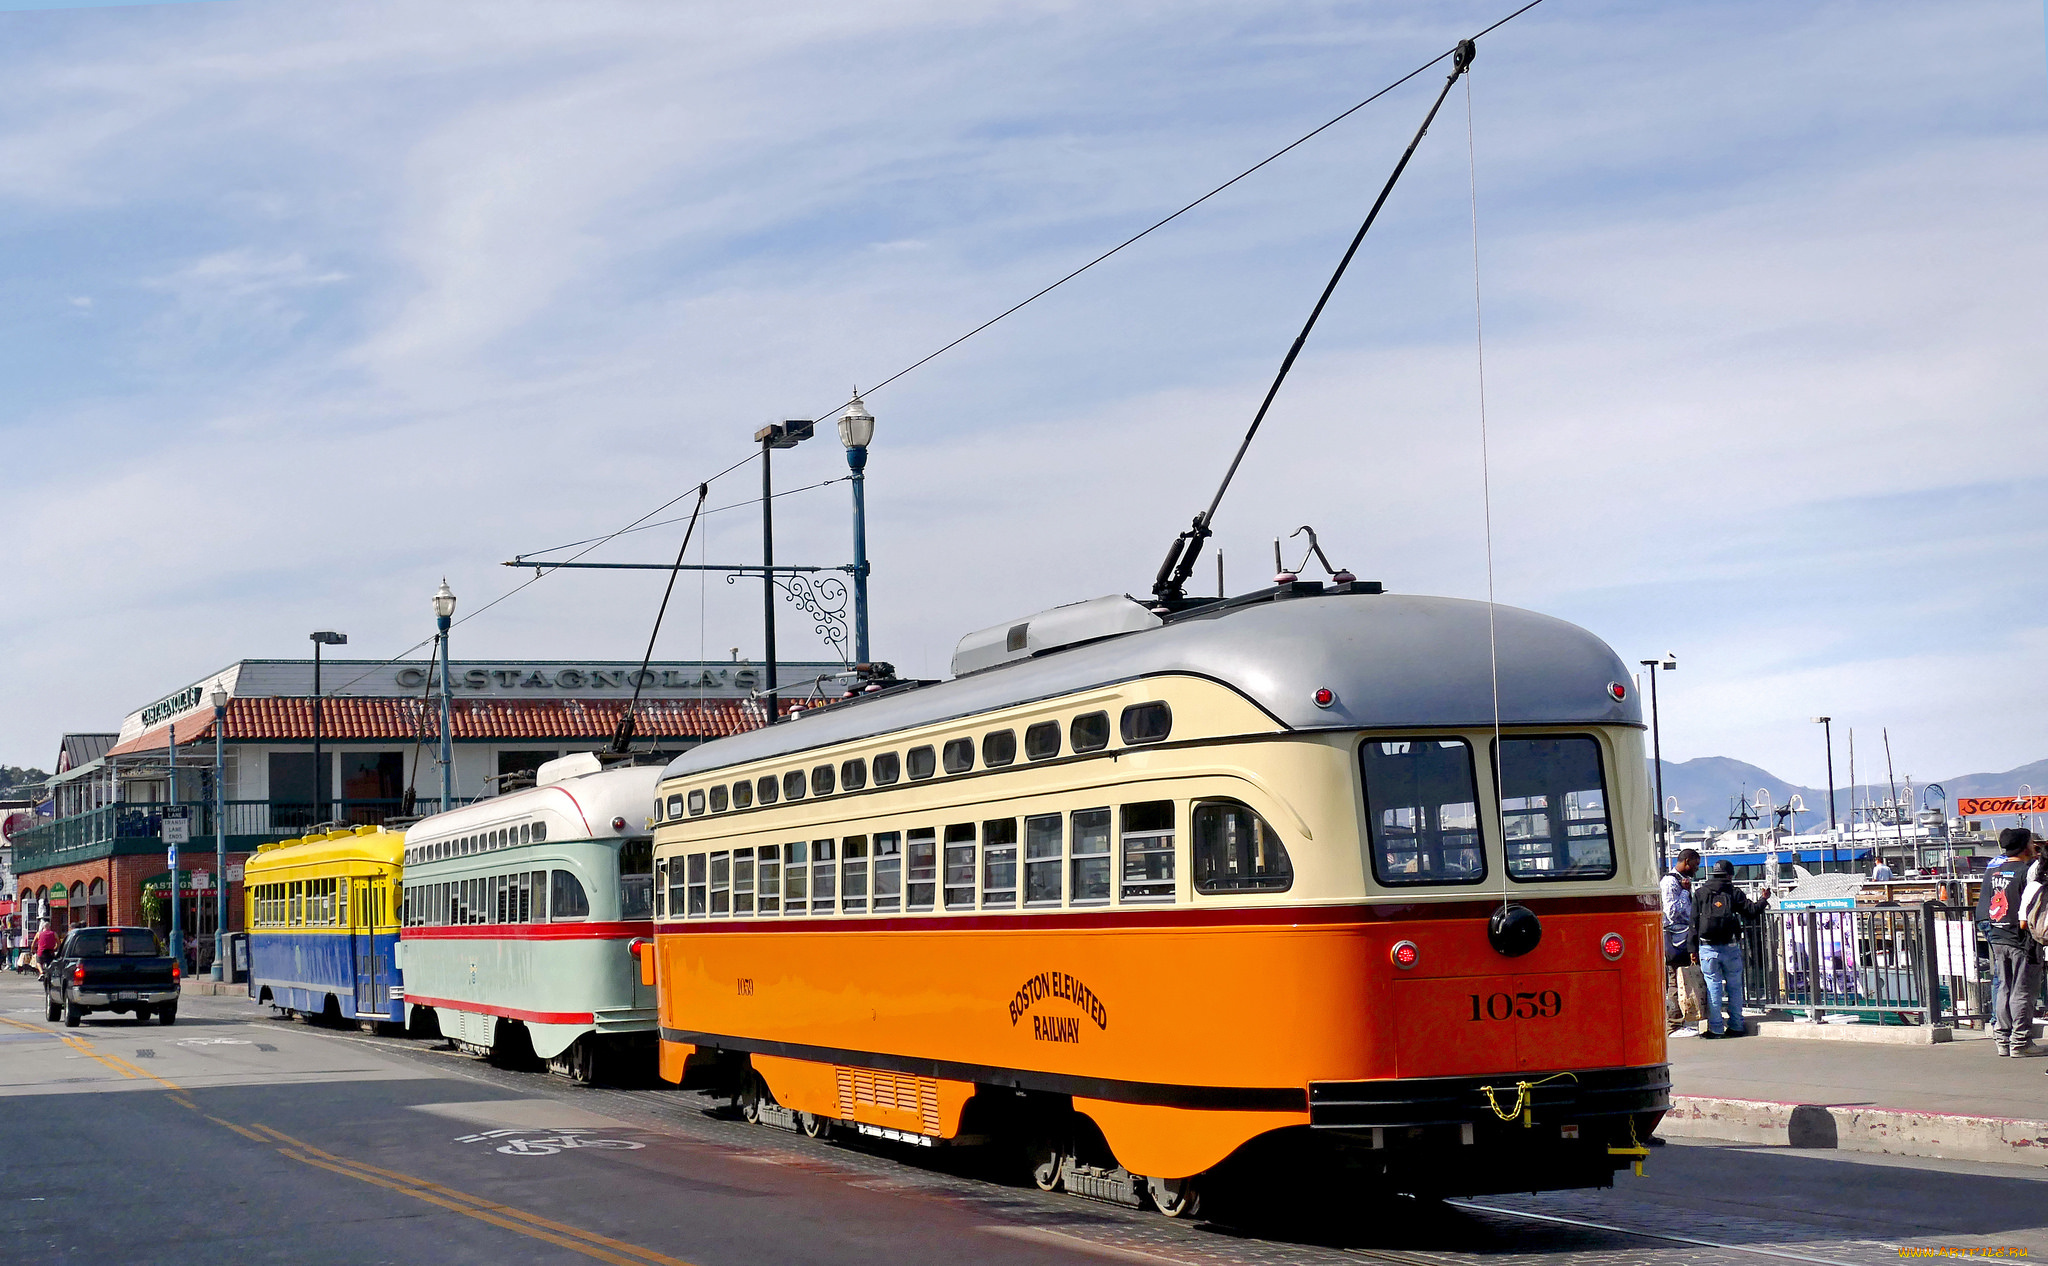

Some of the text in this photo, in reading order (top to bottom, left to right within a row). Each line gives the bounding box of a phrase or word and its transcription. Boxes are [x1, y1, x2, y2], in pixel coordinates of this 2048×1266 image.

[394, 667, 760, 689] CASTAGNOLA'S
[1962, 797, 2047, 814] Scoma's
[1811, 901, 1826, 909] Sport
[1827, 900, 1849, 908] Fishing
[737, 978, 754, 996] 1059
[1009, 971, 1107, 1031] BOSTON ELEVATED
[1467, 989, 1562, 1022] 1059
[1033, 1015, 1080, 1044] RAILWAY
